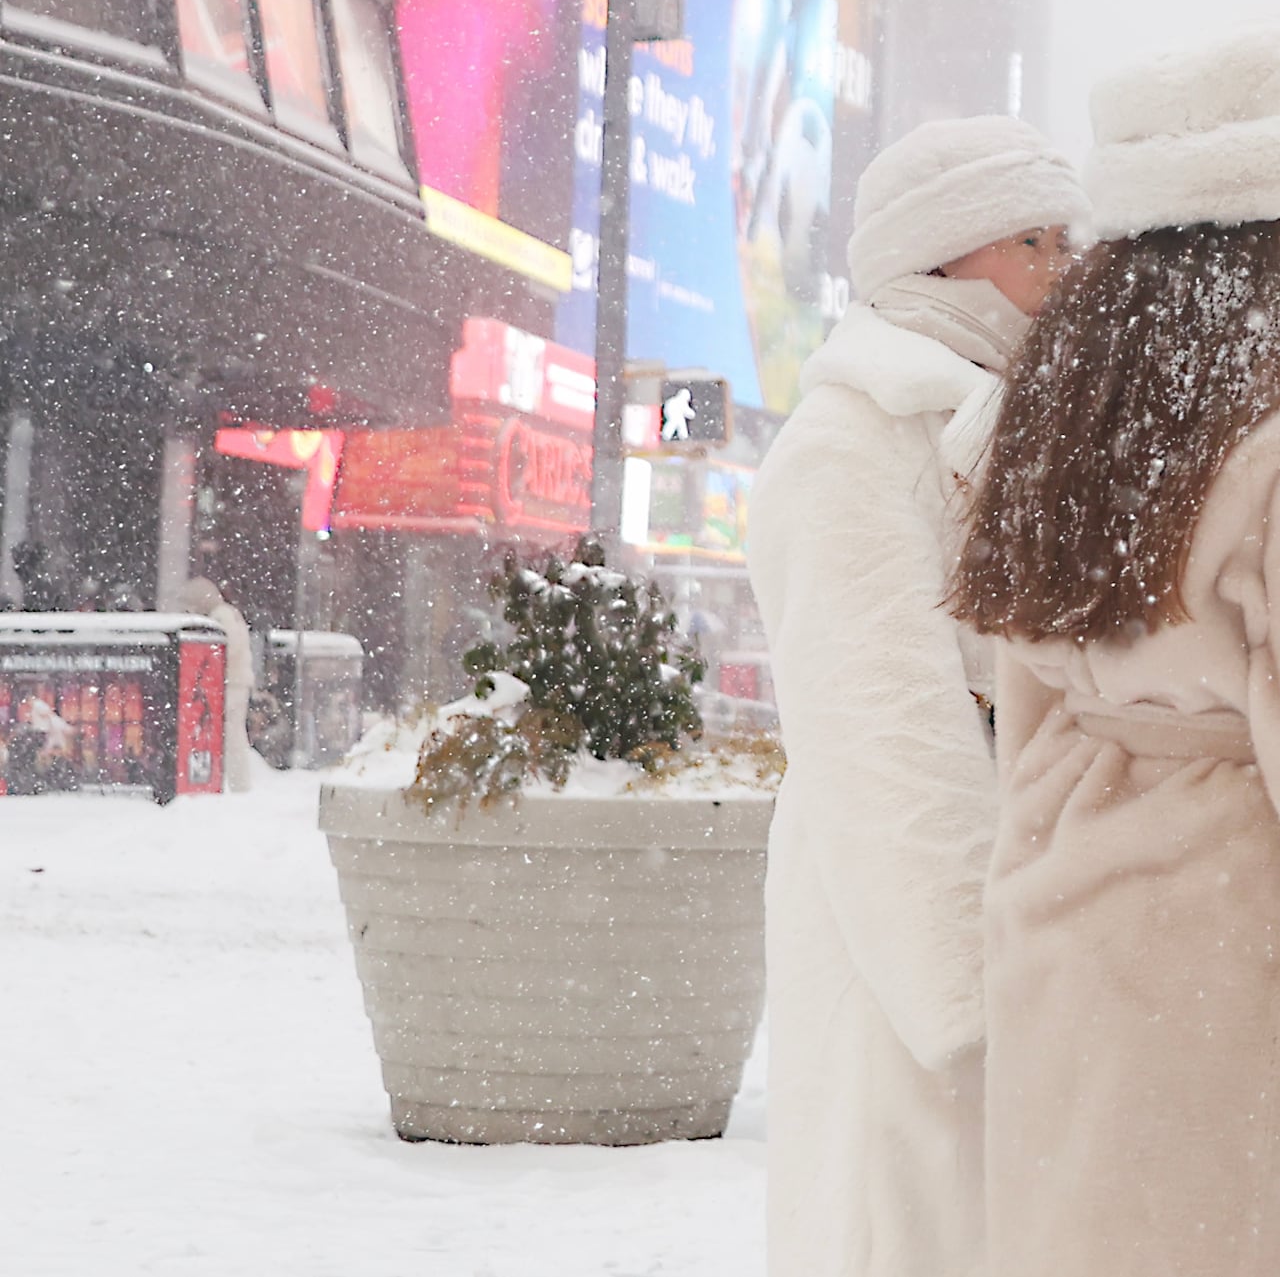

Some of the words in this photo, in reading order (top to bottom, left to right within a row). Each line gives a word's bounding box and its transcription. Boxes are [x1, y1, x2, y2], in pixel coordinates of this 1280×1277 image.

[645, 71, 689, 147] they
[630, 135, 648, 183] &
[650, 150, 697, 207] walk
